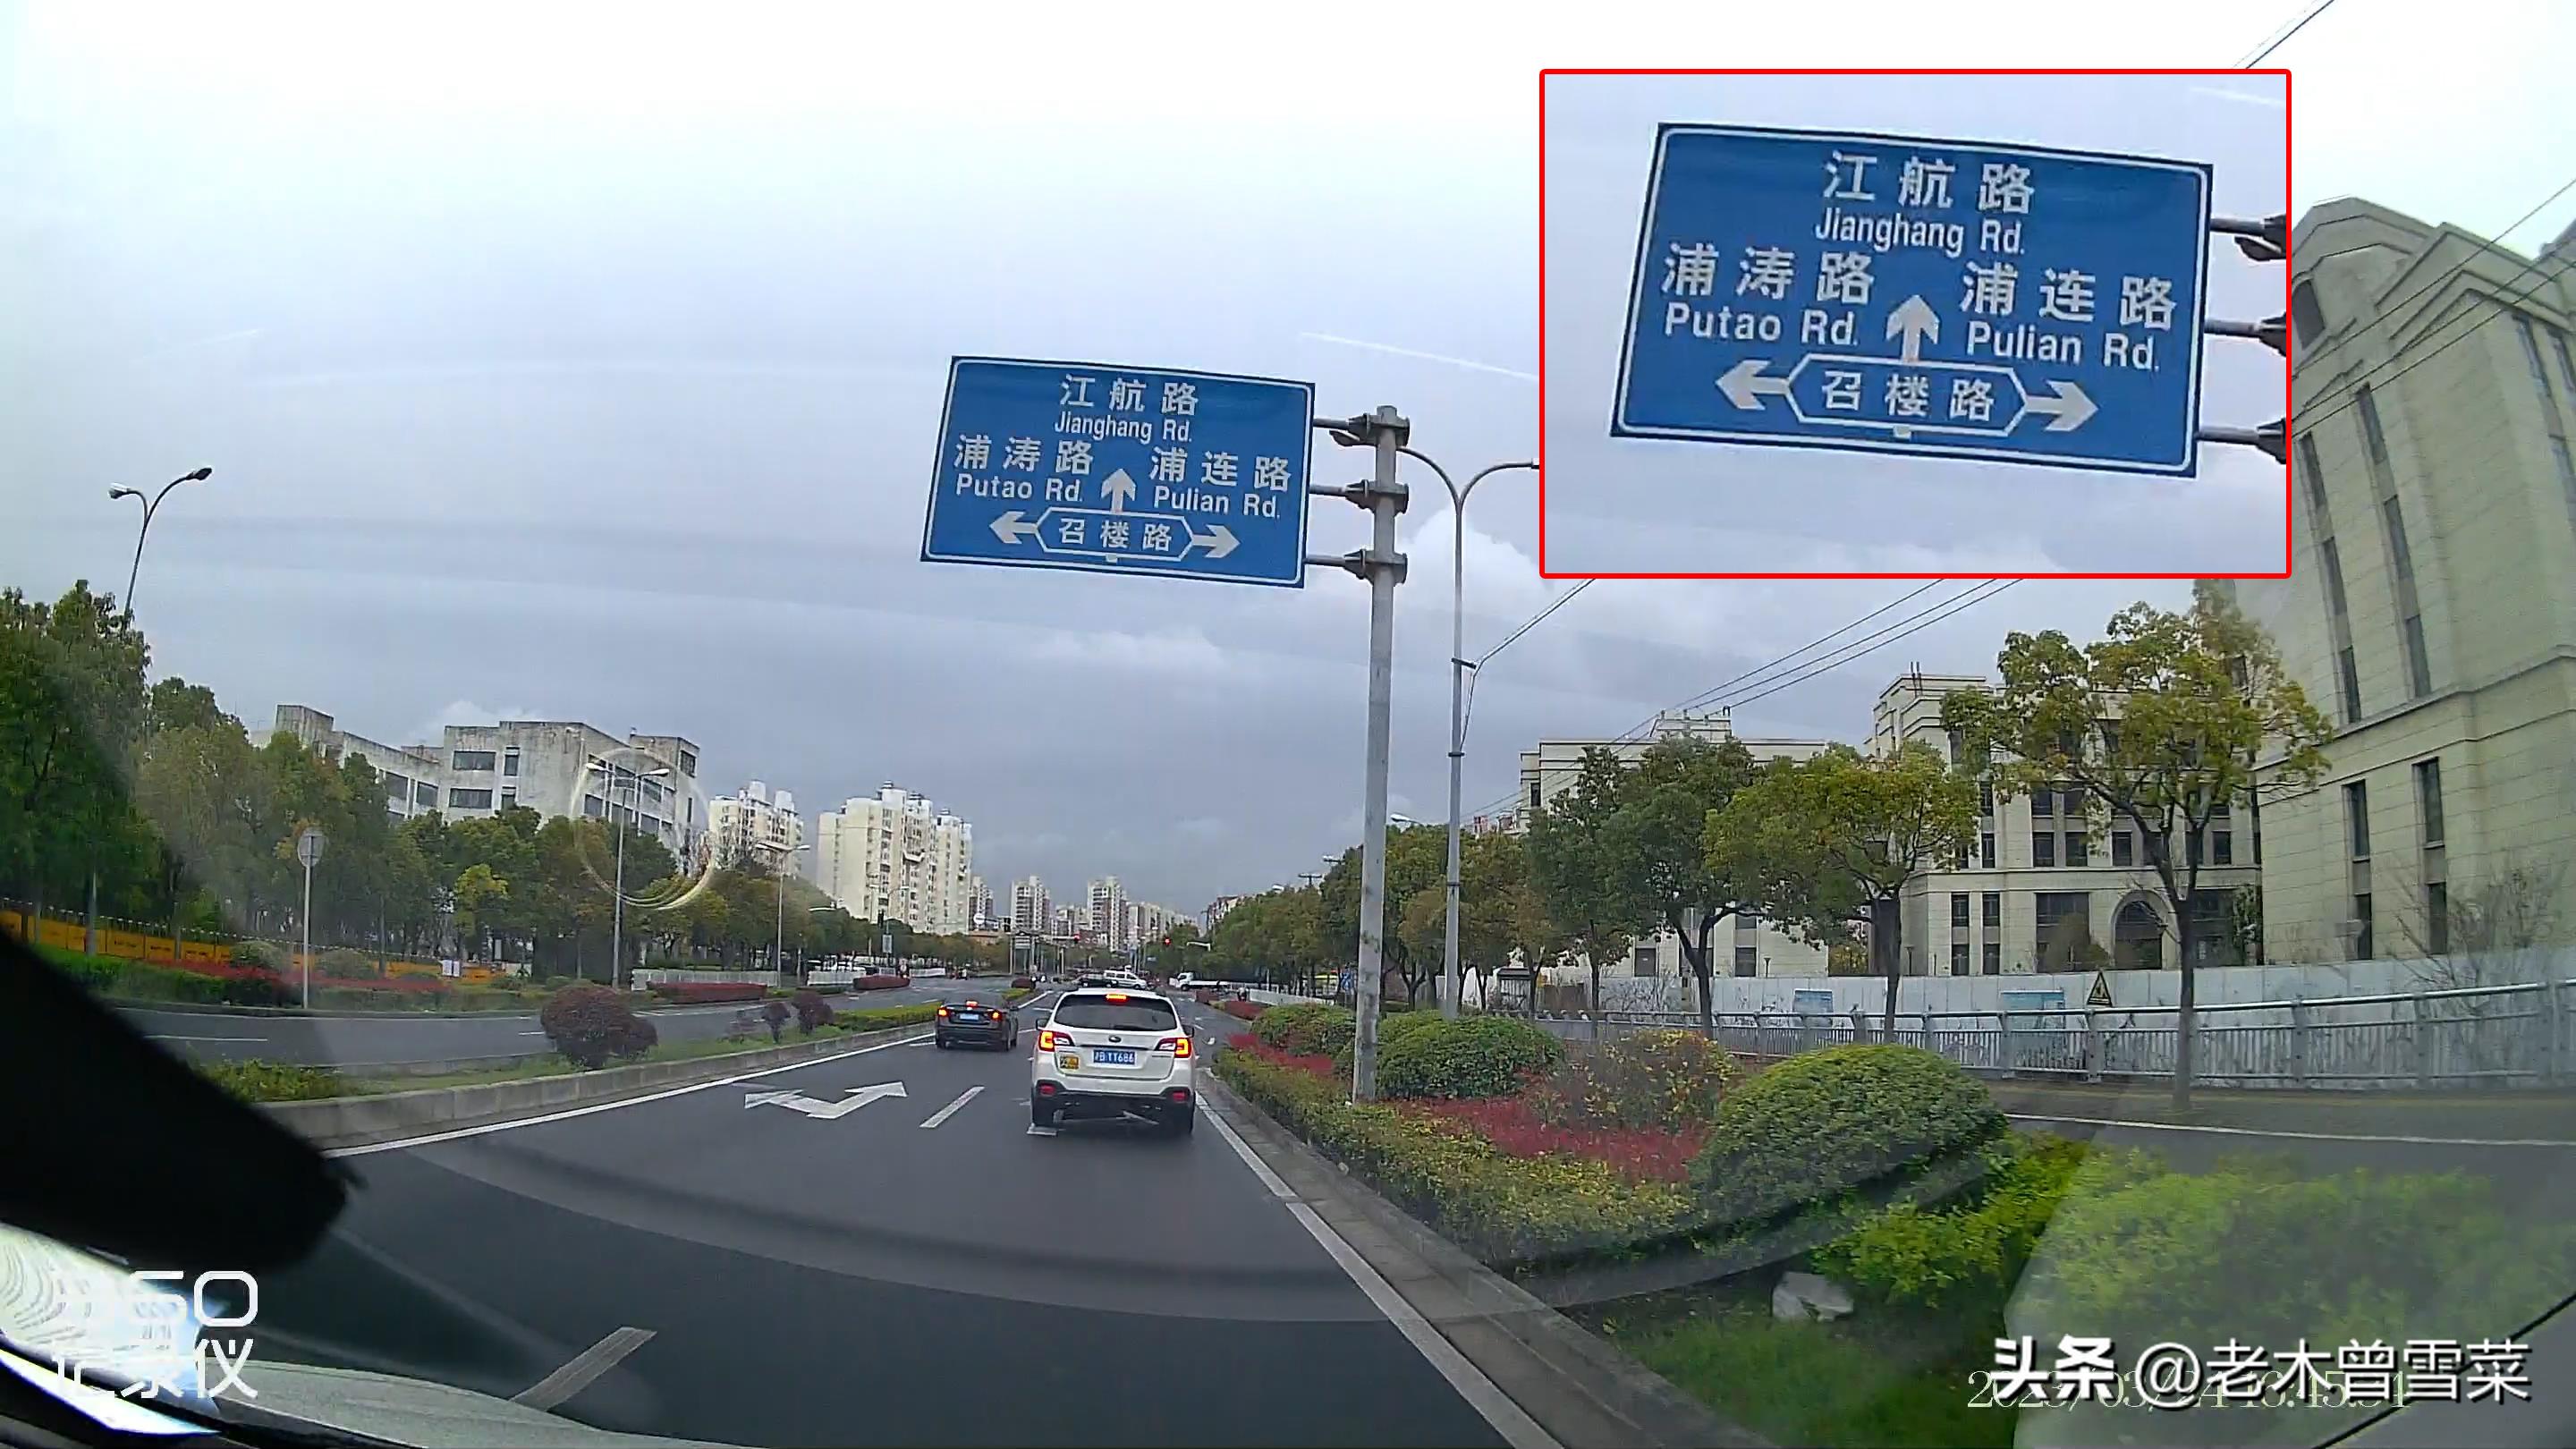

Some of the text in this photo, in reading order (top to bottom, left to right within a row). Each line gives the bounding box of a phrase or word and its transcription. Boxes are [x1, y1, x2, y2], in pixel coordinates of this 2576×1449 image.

[1822, 150, 2035, 215] 江航路
[1815, 208, 1963, 257] Jianghang
[1661, 242, 1876, 305] 浦涛路
[1960, 260, 2177, 332] 浦连路
[1665, 303, 1781, 343] Putao
[1967, 322, 2081, 366] Pulian
[1060, 373, 1198, 417] 江航路
[1821, 371, 1994, 420] 召楼路
[1055, 411, 1152, 444] Jianghang
[953, 434, 1094, 475] 浦涛路
[1149, 445, 1292, 493] 浦连路
[956, 474, 1032, 499] Putao
[1154, 486, 1229, 514] Pulian
[1059, 519, 1173, 551] 召楼路
